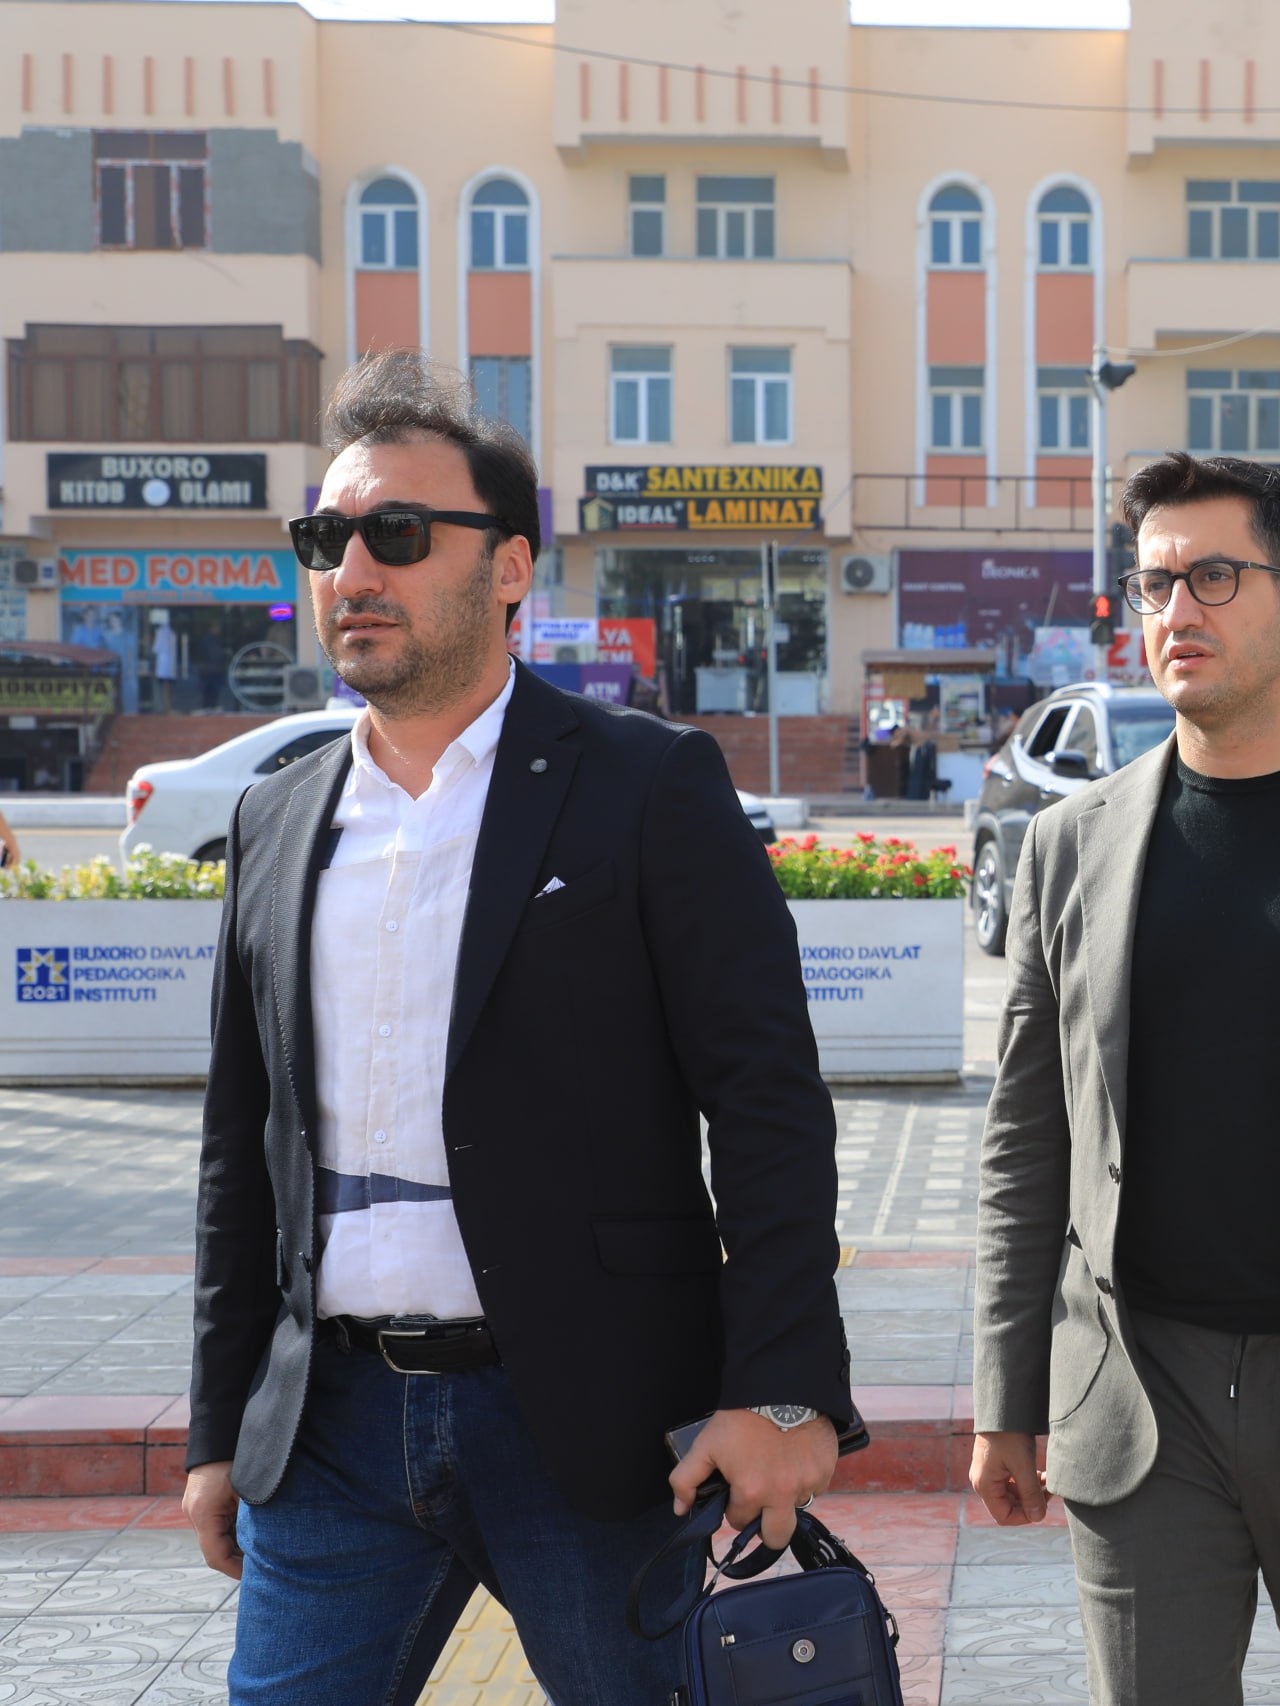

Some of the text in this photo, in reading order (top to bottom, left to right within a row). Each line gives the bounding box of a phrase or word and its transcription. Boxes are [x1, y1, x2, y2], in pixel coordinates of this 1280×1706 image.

[101, 456, 210, 478] BUXORO
[596, 466, 820, 491] D&K SANTEXNIKA
[59, 480, 251, 504] KITOB OLAMI
[617, 499, 817, 524] IDEAL LAMINAT
[59, 555, 280, 588] MED FORMA
[583, 682, 620, 698] ATM
[73, 946, 216, 960] BUXORO DAVLAT
[858, 945, 921, 960] DAVLAT
[73, 966, 186, 981] PEDAGOGIKA
[803, 966, 892, 981] DAGOGIKA
[21, 986, 66, 1000] 2021
[73, 987, 157, 1001] INSTITUTI
[806, 986, 864, 1001] STITUTI
